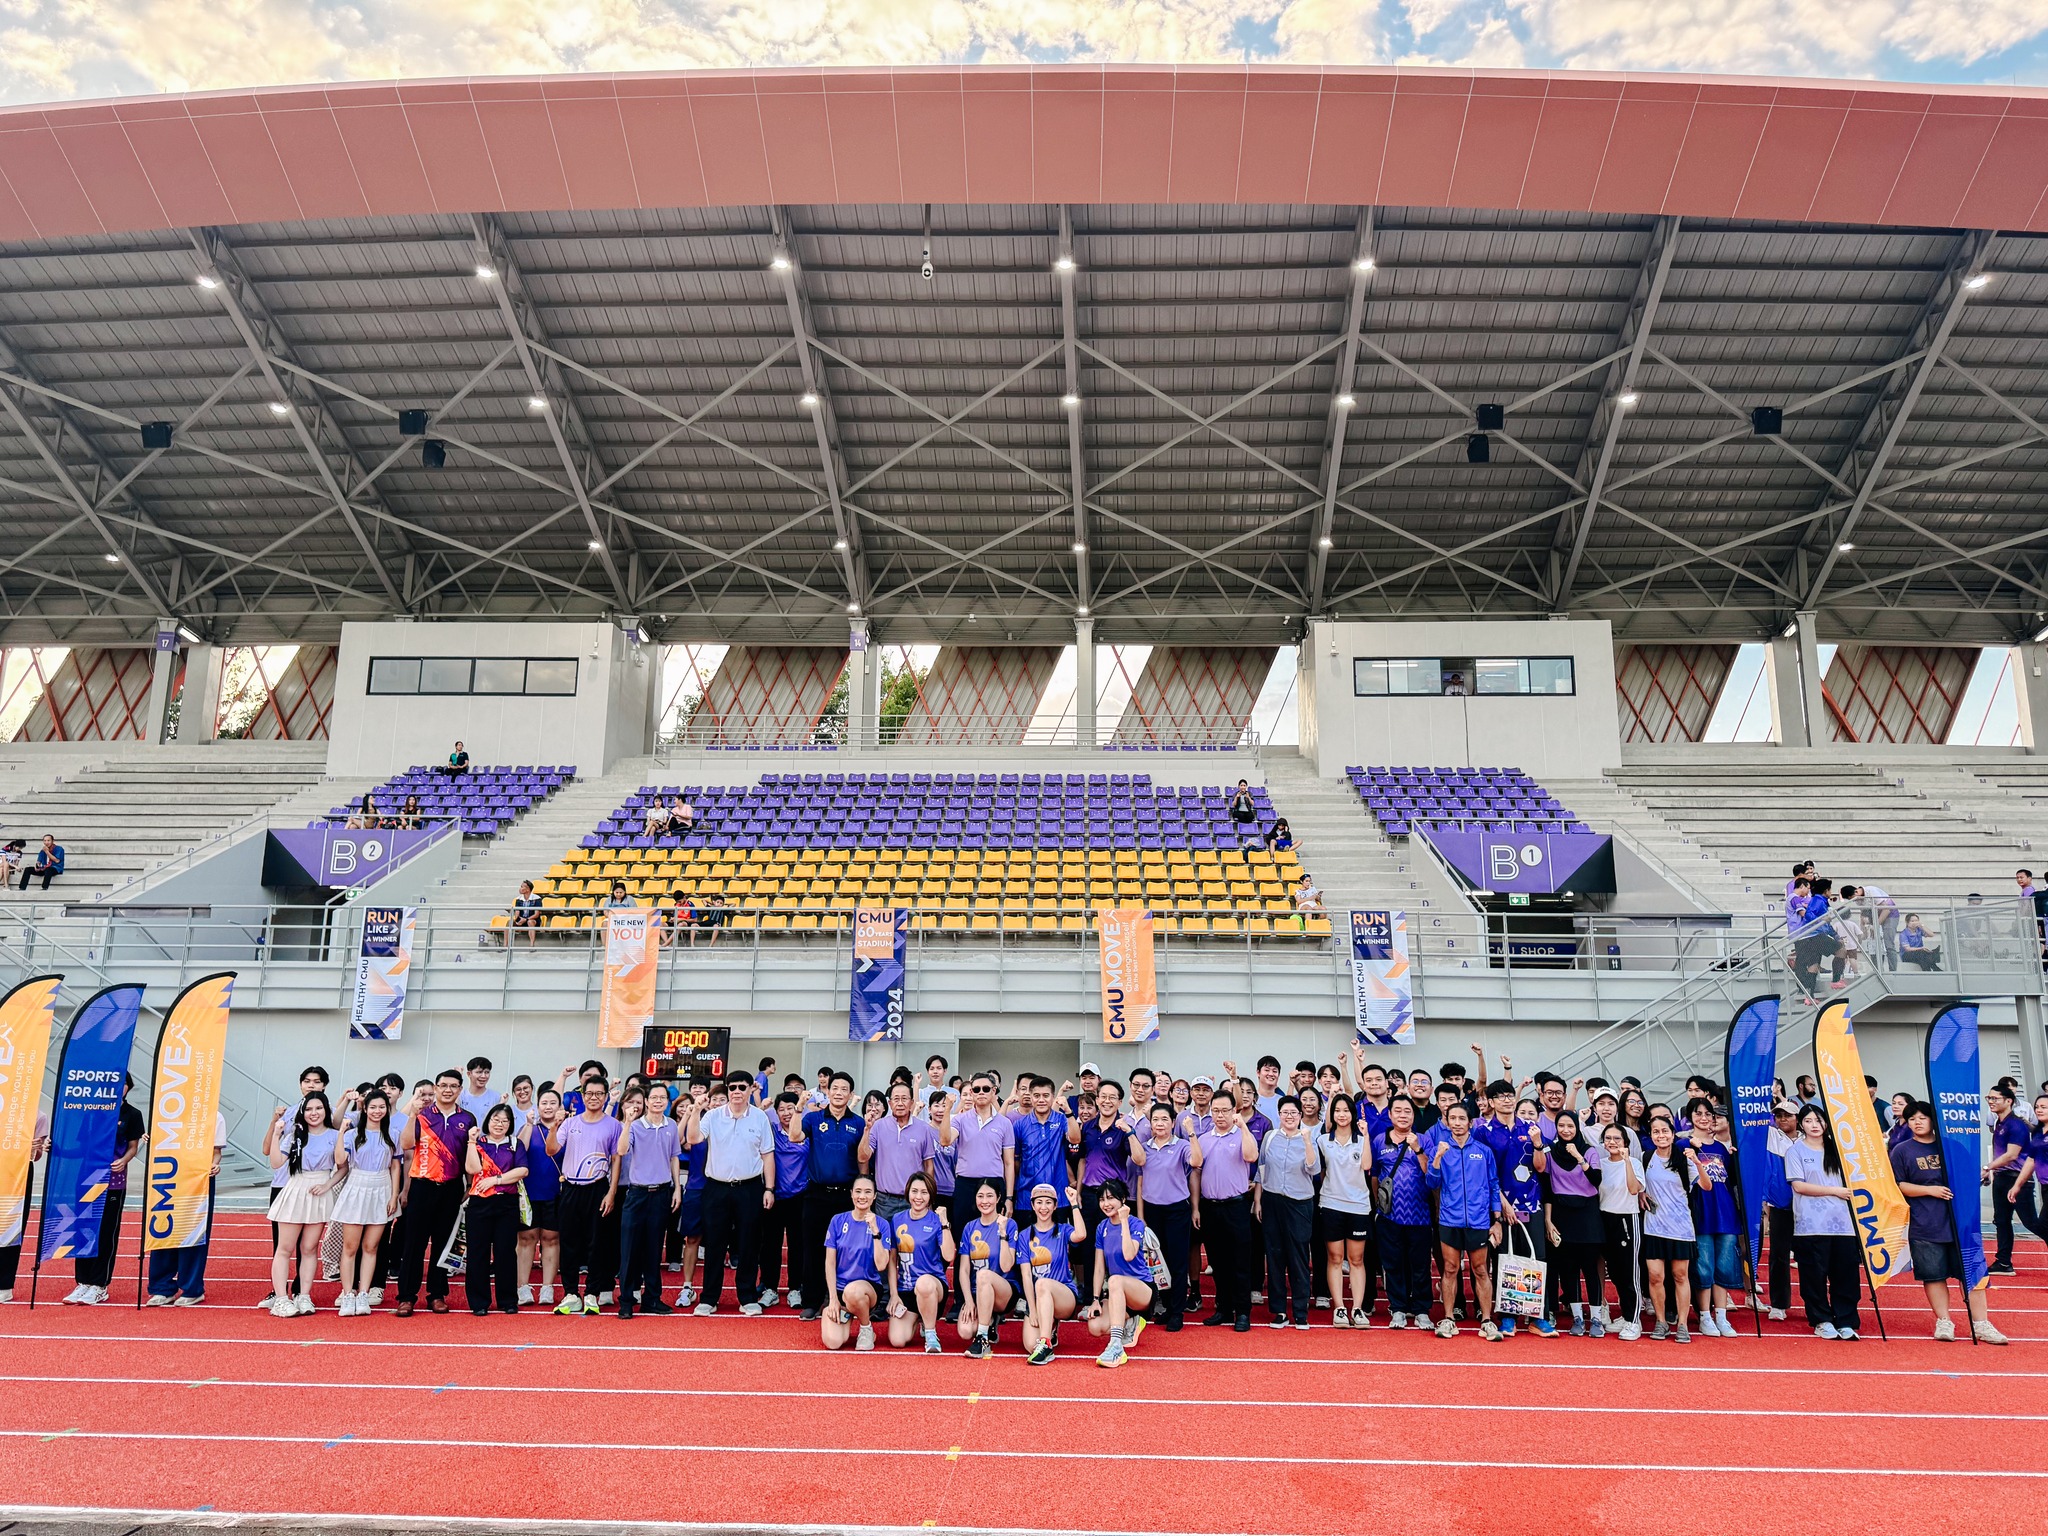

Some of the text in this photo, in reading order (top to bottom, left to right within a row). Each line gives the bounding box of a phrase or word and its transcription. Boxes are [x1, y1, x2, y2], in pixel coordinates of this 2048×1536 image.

[162, 639, 170, 647] 17
[330, 840, 376, 874] B 2
[1490, 845, 1535, 880] B 1
[367, 911, 399, 923] RUN
[858, 912, 892, 923] CMU
[1353, 913, 1386, 926] RUN
[1433, 919, 1441, 927] C
[367, 925, 389, 934] LIKE
[612, 928, 644, 941] YOU
[857, 926, 875, 938] 60
[1355, 927, 1378, 936] LIKE
[479, 934, 486, 942] B
[857, 940, 892, 948] STADIUM
[1447, 940, 1455, 948] B
[1520, 946, 1556, 955] SHOP
[1122, 921, 1133, 993] Challenge yourself
[1103, 923, 1126, 1039] CMU MOVE
[355, 959, 369, 1022] HEALTHY CMU
[1356, 962, 1368, 1027] HEALTHY CMU
[886, 988, 904, 1039] 2024
[665, 1031, 709, 1048] 00:00
[646, 1059, 658, 1076] 0
[712, 1059, 723, 1077] 0
[68, 1070, 120, 1082] SPORTS
[65, 1086, 118, 1098] FOR ALL
[2, 1096, 18, 1151] Challenge
[14, 1052, 26, 1094] yourself
[83, 1102, 117, 1111] yourself
[185, 1051, 204, 1150] Challenge yourself
[1739, 1102, 1761, 1114] FOR
[1942, 1109, 1968, 1121] FOR
[1741, 1119, 1757, 1127] Love
[1844, 1079, 1877, 1179] Challenge yourself
[1945, 1125, 1964, 1134] Love
[149, 1046, 192, 1239] CMU MOVE
[1823, 1074, 1891, 1275] CMU MOVE
[842, 1222, 849, 1233] 8
